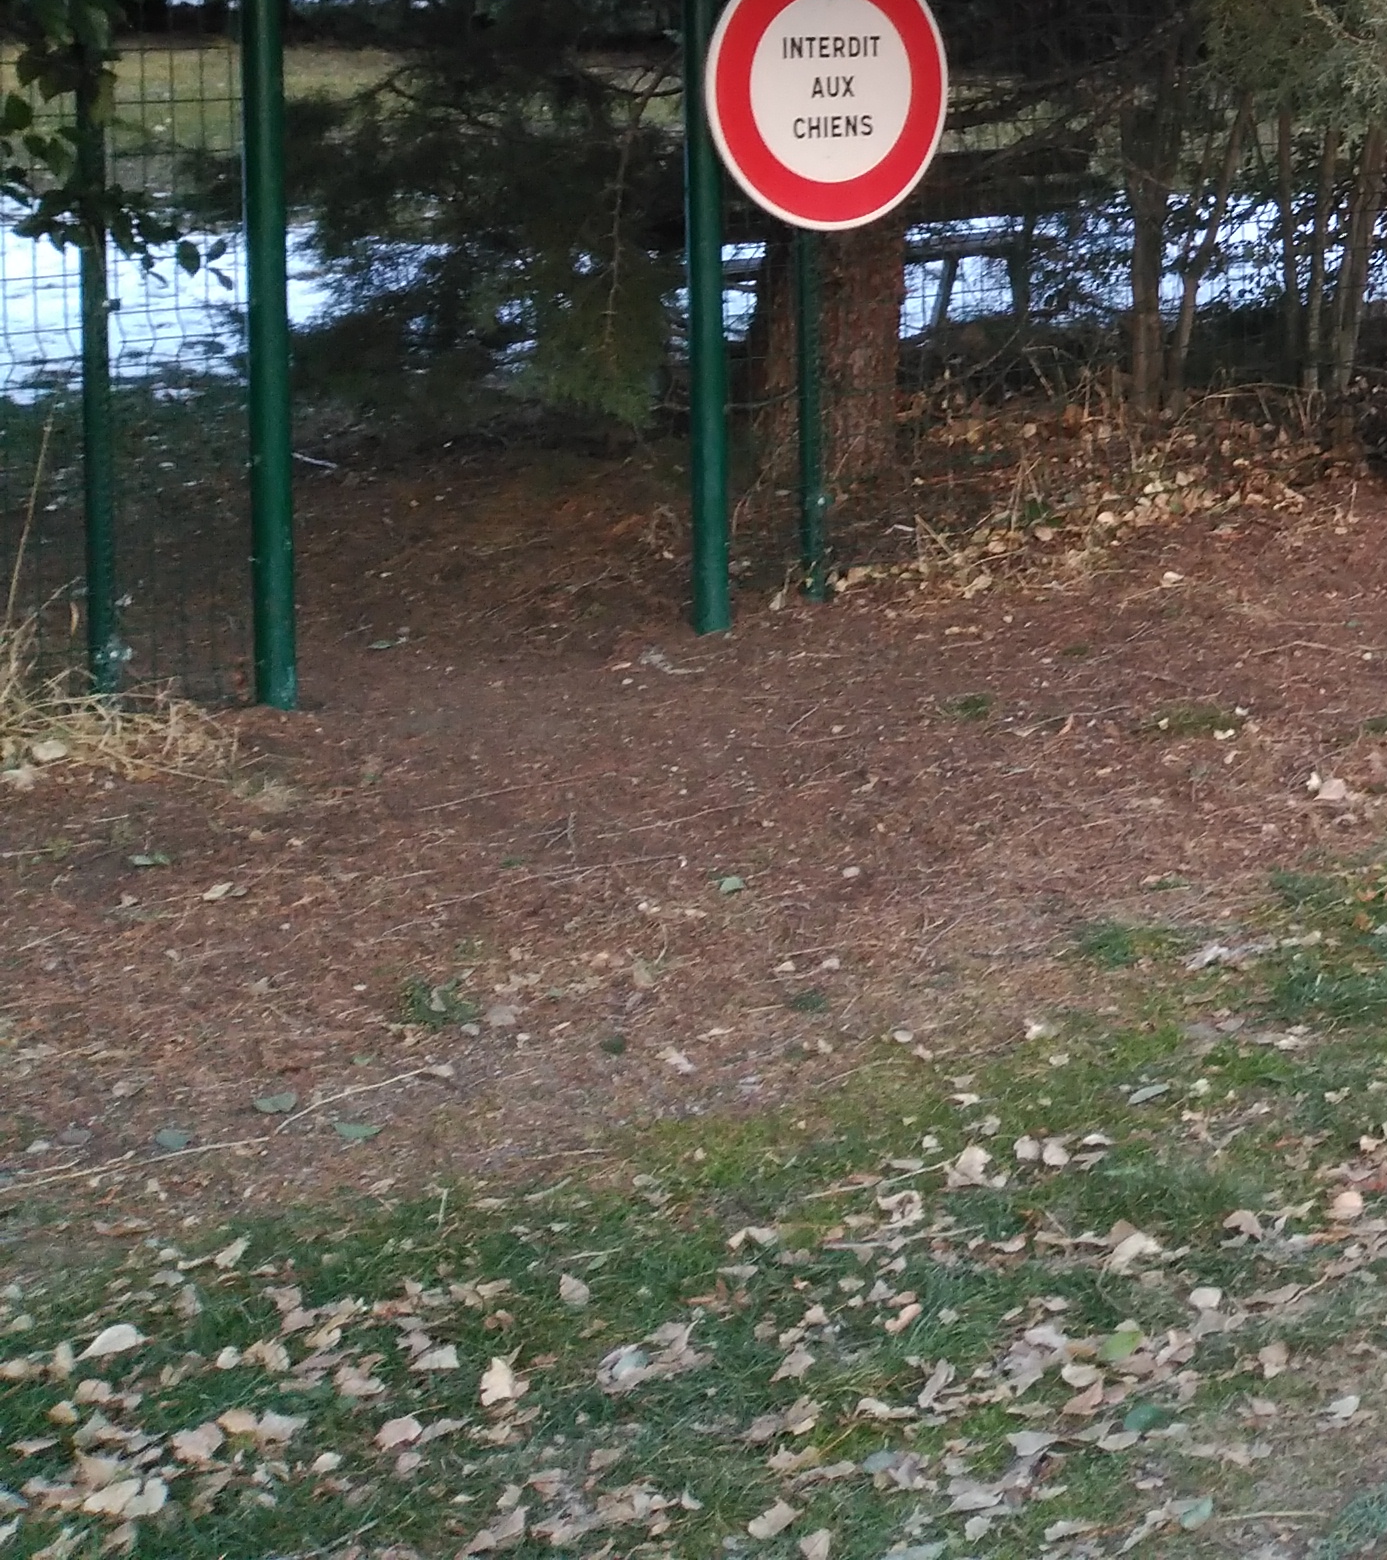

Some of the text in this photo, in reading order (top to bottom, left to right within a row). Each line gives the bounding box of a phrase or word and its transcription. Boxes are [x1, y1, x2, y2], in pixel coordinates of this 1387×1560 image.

[782, 35, 881, 59] INTERDIT
[811, 75, 855, 98] AUX
[793, 115, 873, 139] CHIENS
